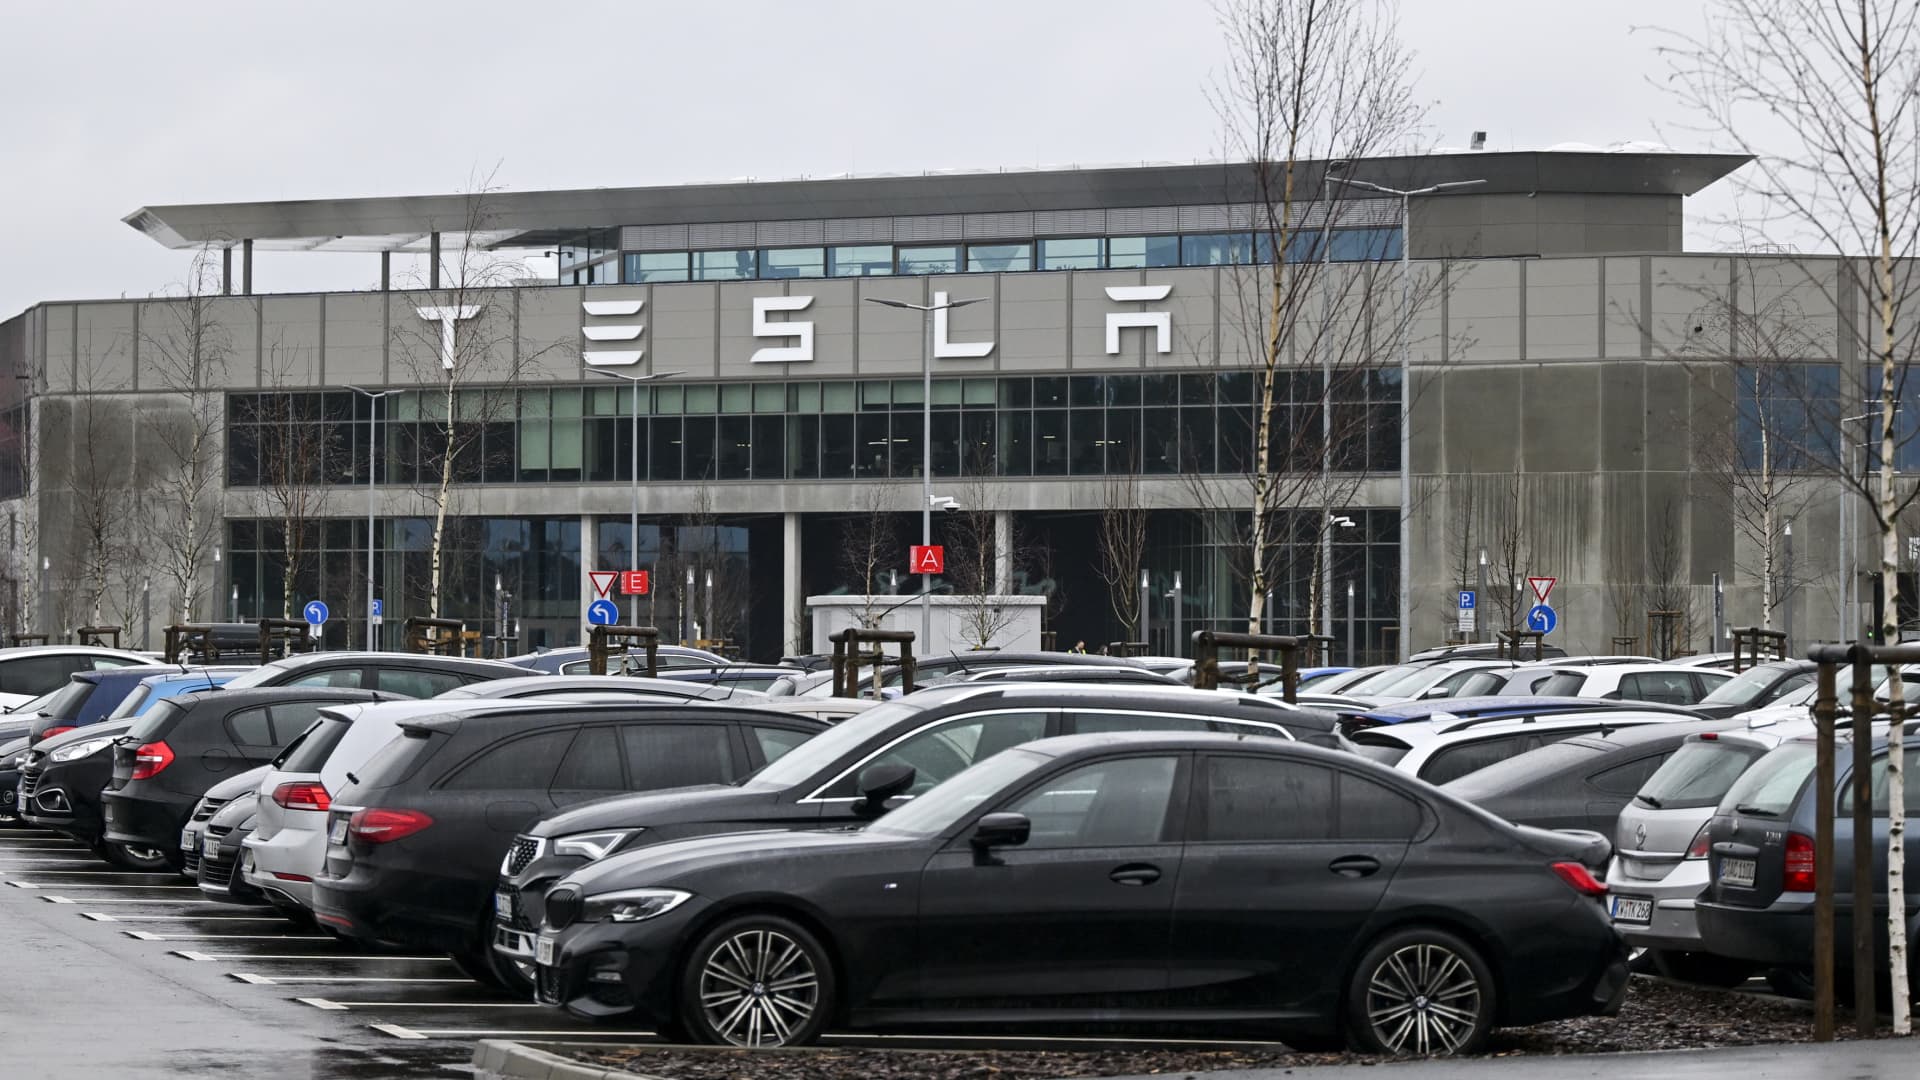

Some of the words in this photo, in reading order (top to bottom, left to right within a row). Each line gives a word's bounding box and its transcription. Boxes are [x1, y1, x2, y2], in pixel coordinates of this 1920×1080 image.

[416, 285, 1173, 369] TESLA
[921, 549, 938, 567] A
[631, 573, 642, 589] E
[1461, 593, 1470, 607] P
[1636, 902, 1650, 919] 268
